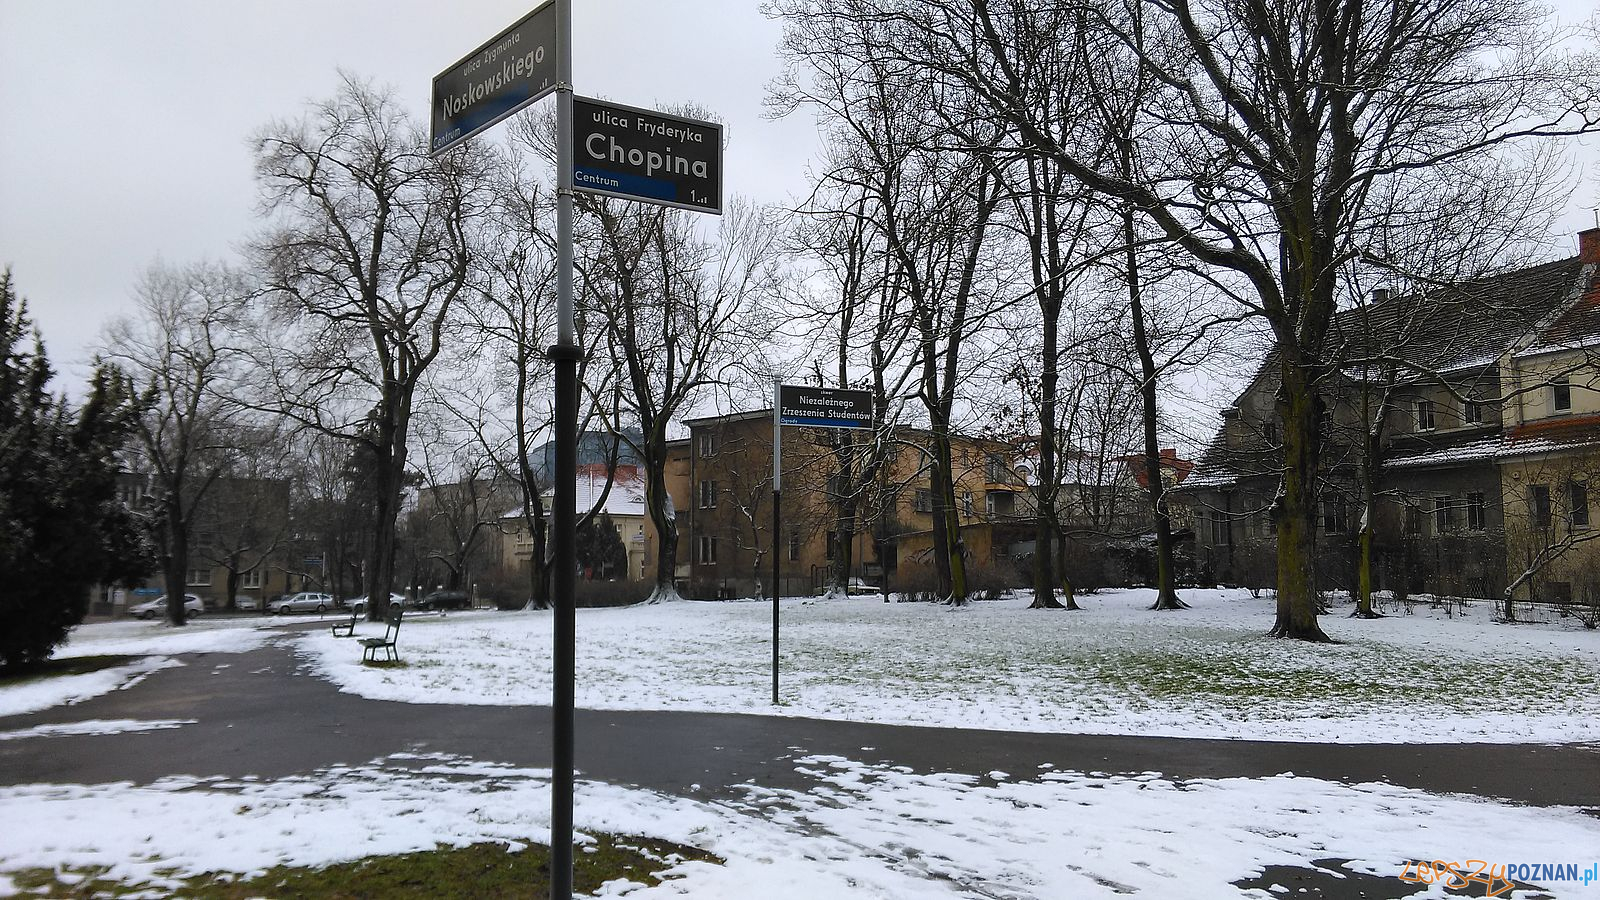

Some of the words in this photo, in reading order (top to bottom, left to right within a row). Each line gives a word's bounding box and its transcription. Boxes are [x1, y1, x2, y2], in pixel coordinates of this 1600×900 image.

[464, 60, 480, 76] ulica
[484, 33, 520, 64] Zygmunta
[443, 46, 544, 120] Noskowskiego
[433, 128, 460, 148] Centrum
[593, 111, 628, 128] ulica
[637, 118, 702, 142] Fryderyka
[586, 133, 707, 179] Chopina
[575, 171, 618, 186] Centrum
[782, 407, 824, 417] Zrzeszenia
[828, 410, 870, 420] Studentów
[800, 396, 853, 409] Niezależnego
